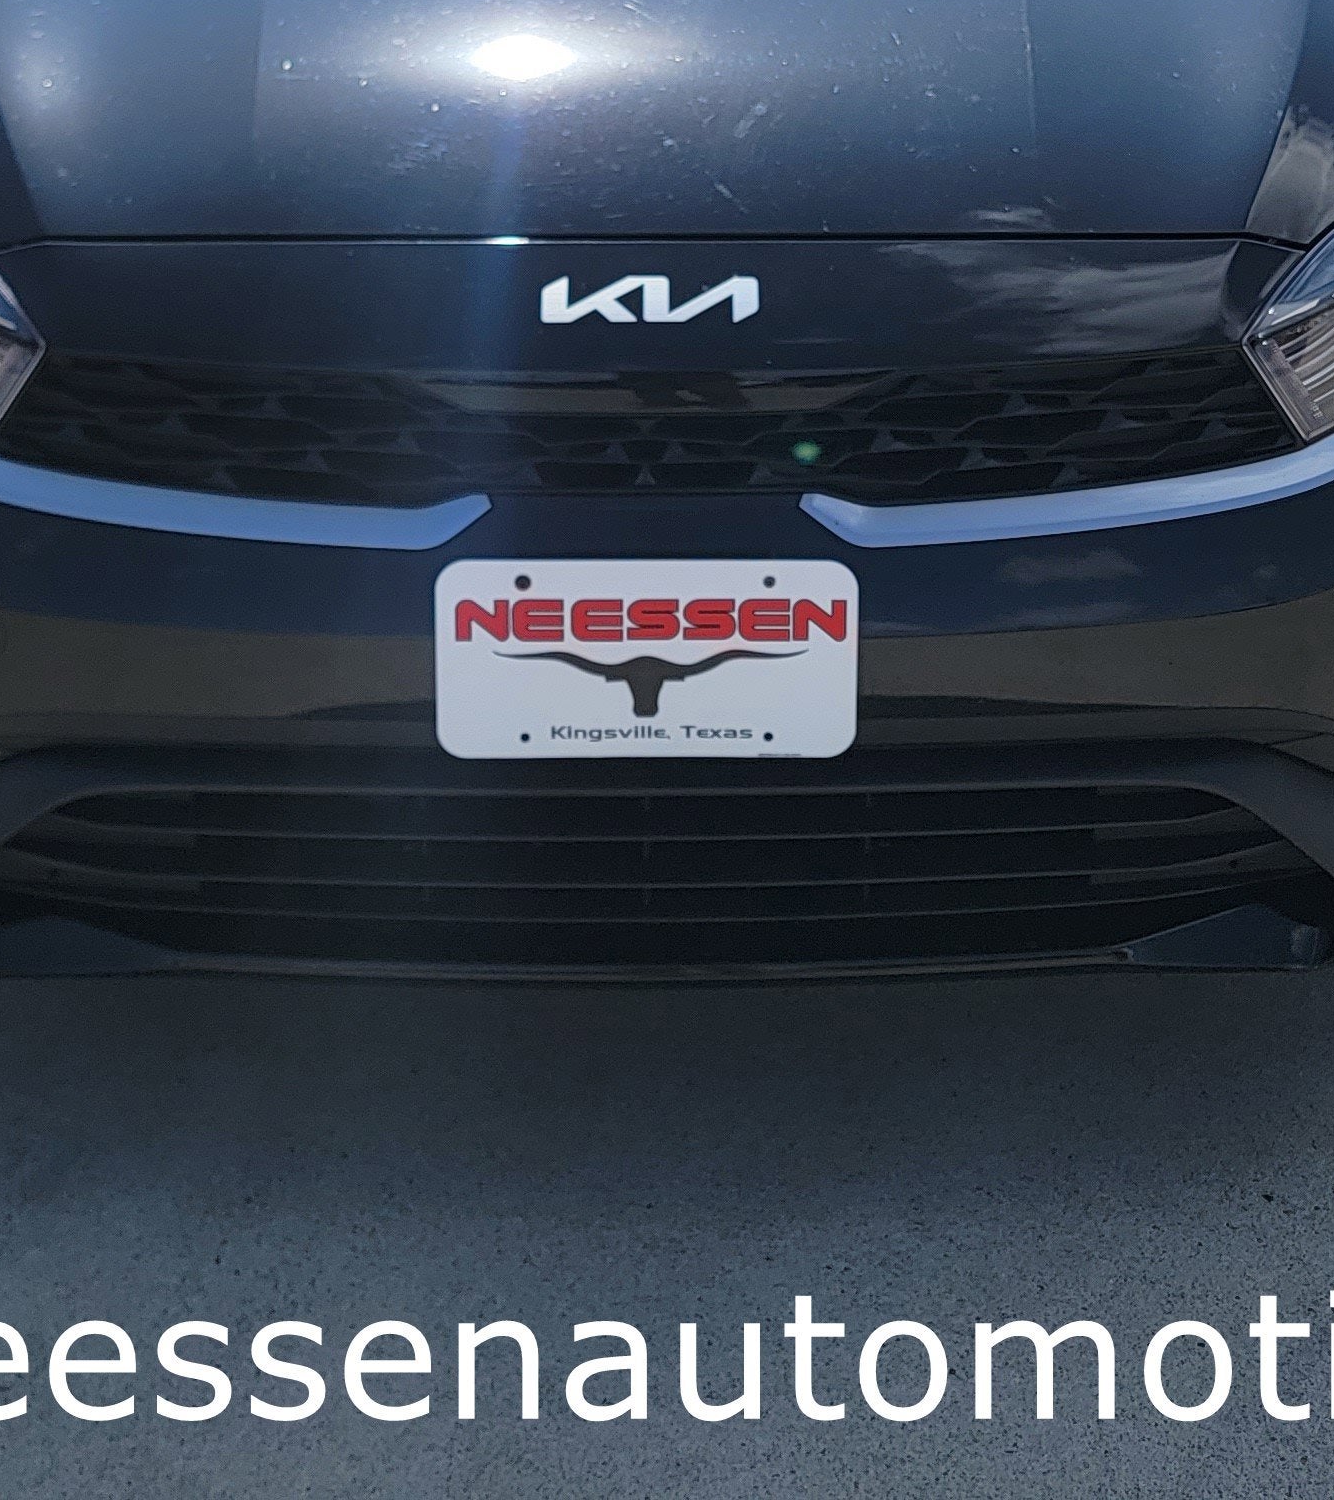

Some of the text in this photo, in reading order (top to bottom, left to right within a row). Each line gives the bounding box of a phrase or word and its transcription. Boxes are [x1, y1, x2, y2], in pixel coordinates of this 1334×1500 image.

[540, 274, 760, 324] KIA
[454, 599, 848, 642] NEESSEN
[550, 725, 753, 742] Kingsville, Texas
